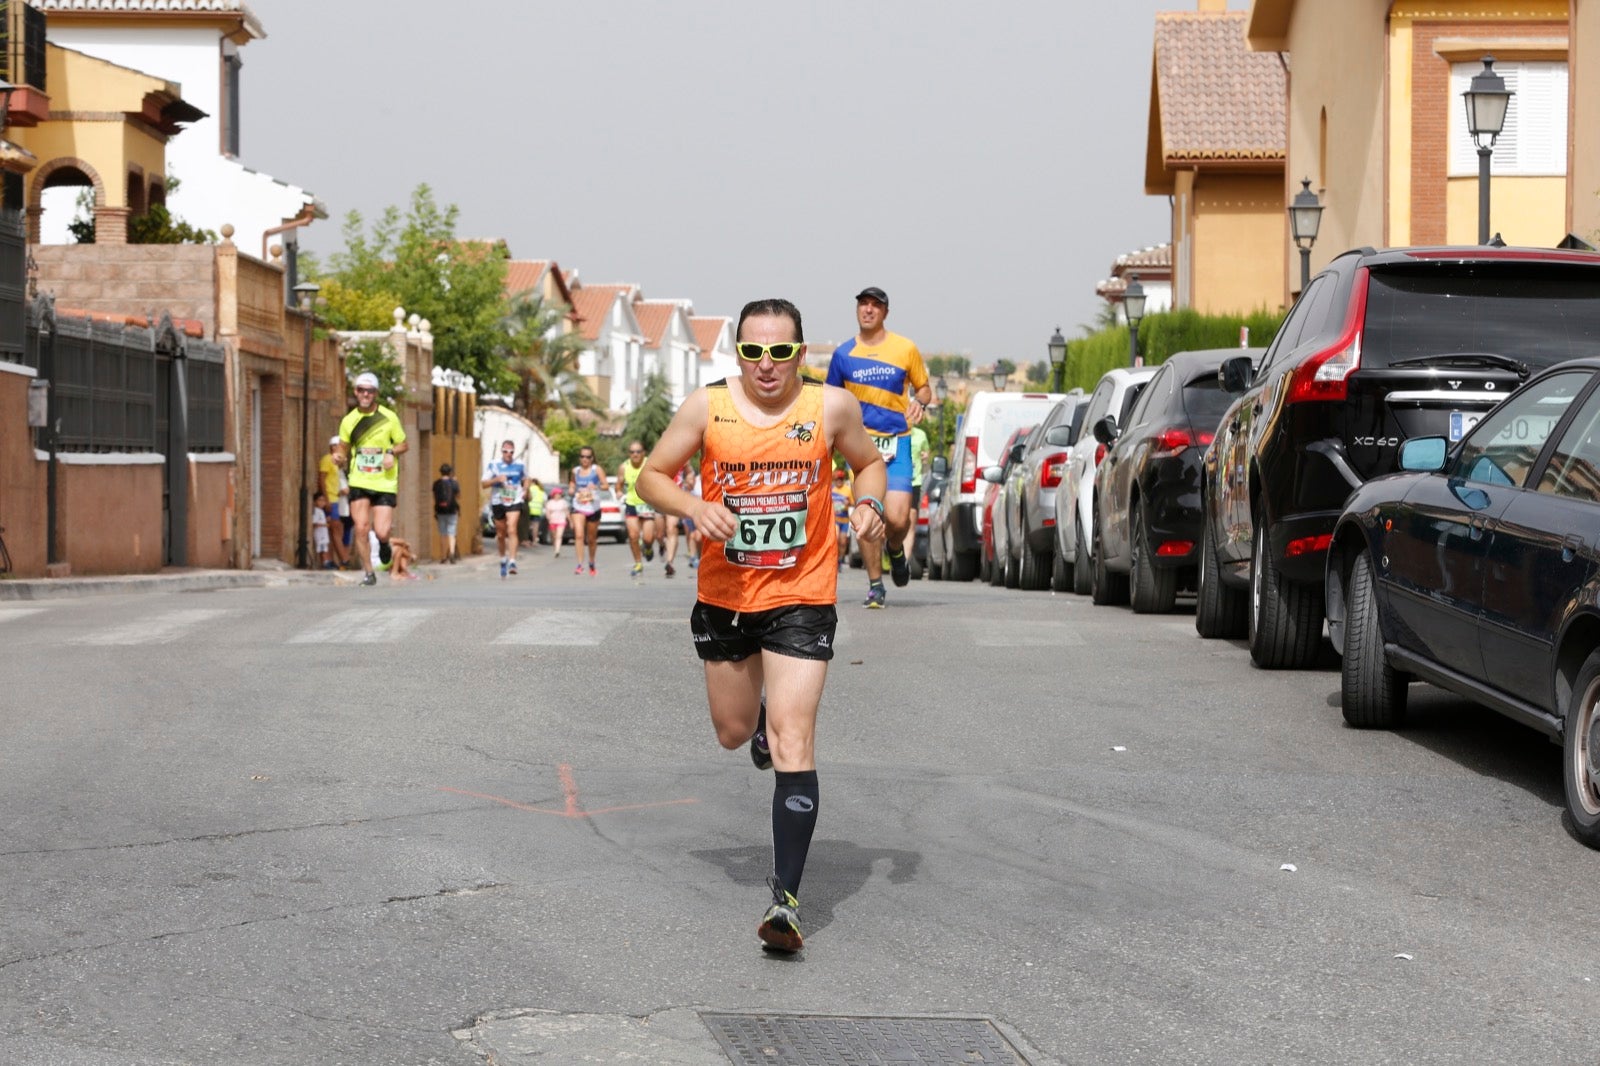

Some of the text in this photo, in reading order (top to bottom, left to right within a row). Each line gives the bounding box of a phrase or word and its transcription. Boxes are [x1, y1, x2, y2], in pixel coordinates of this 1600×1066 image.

[852, 365, 896, 381] agustinos
[720, 459, 812, 472] Club Deportivo
[740, 496, 756, 507] GRAN
[756, 495, 777, 506] PREMIO
[778, 495, 786, 504] DE
[786, 493, 804, 504] FONDO
[740, 516, 797, 546] 670
